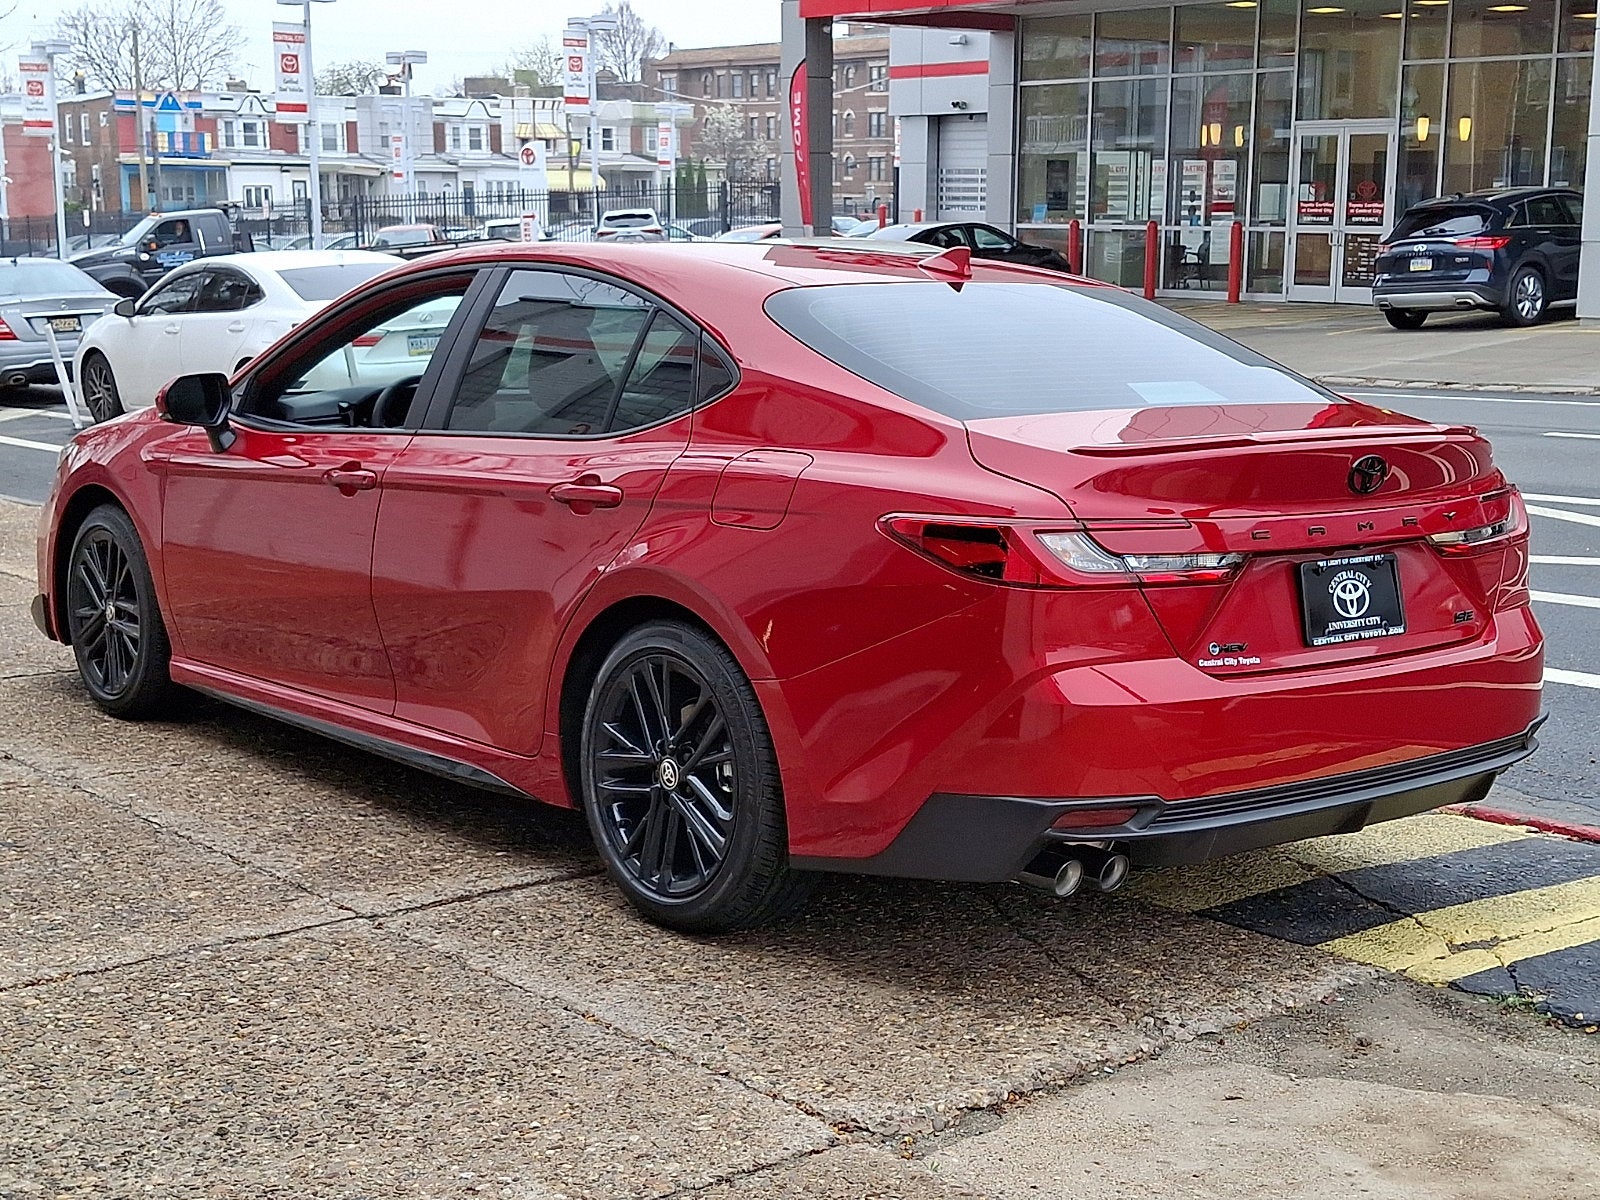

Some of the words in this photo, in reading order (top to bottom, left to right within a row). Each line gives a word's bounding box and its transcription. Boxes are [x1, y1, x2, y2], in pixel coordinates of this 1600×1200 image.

[1252, 512, 1456, 540] CAMRY
[1328, 570, 1355, 594] CENTRAL
[1355, 571, 1372, 588] CITY
[1328, 617, 1366, 631] UNIVERSITY
[1366, 616, 1381, 625] CITY
[1313, 636, 1343, 646] CENTRAL
[1344, 634, 1359, 642] CITY
[1360, 629, 1387, 639] TOYOTA
[1199, 658, 1223, 666] Central
[1224, 657, 1237, 666] City
[1238, 656, 1260, 665] Toyota
